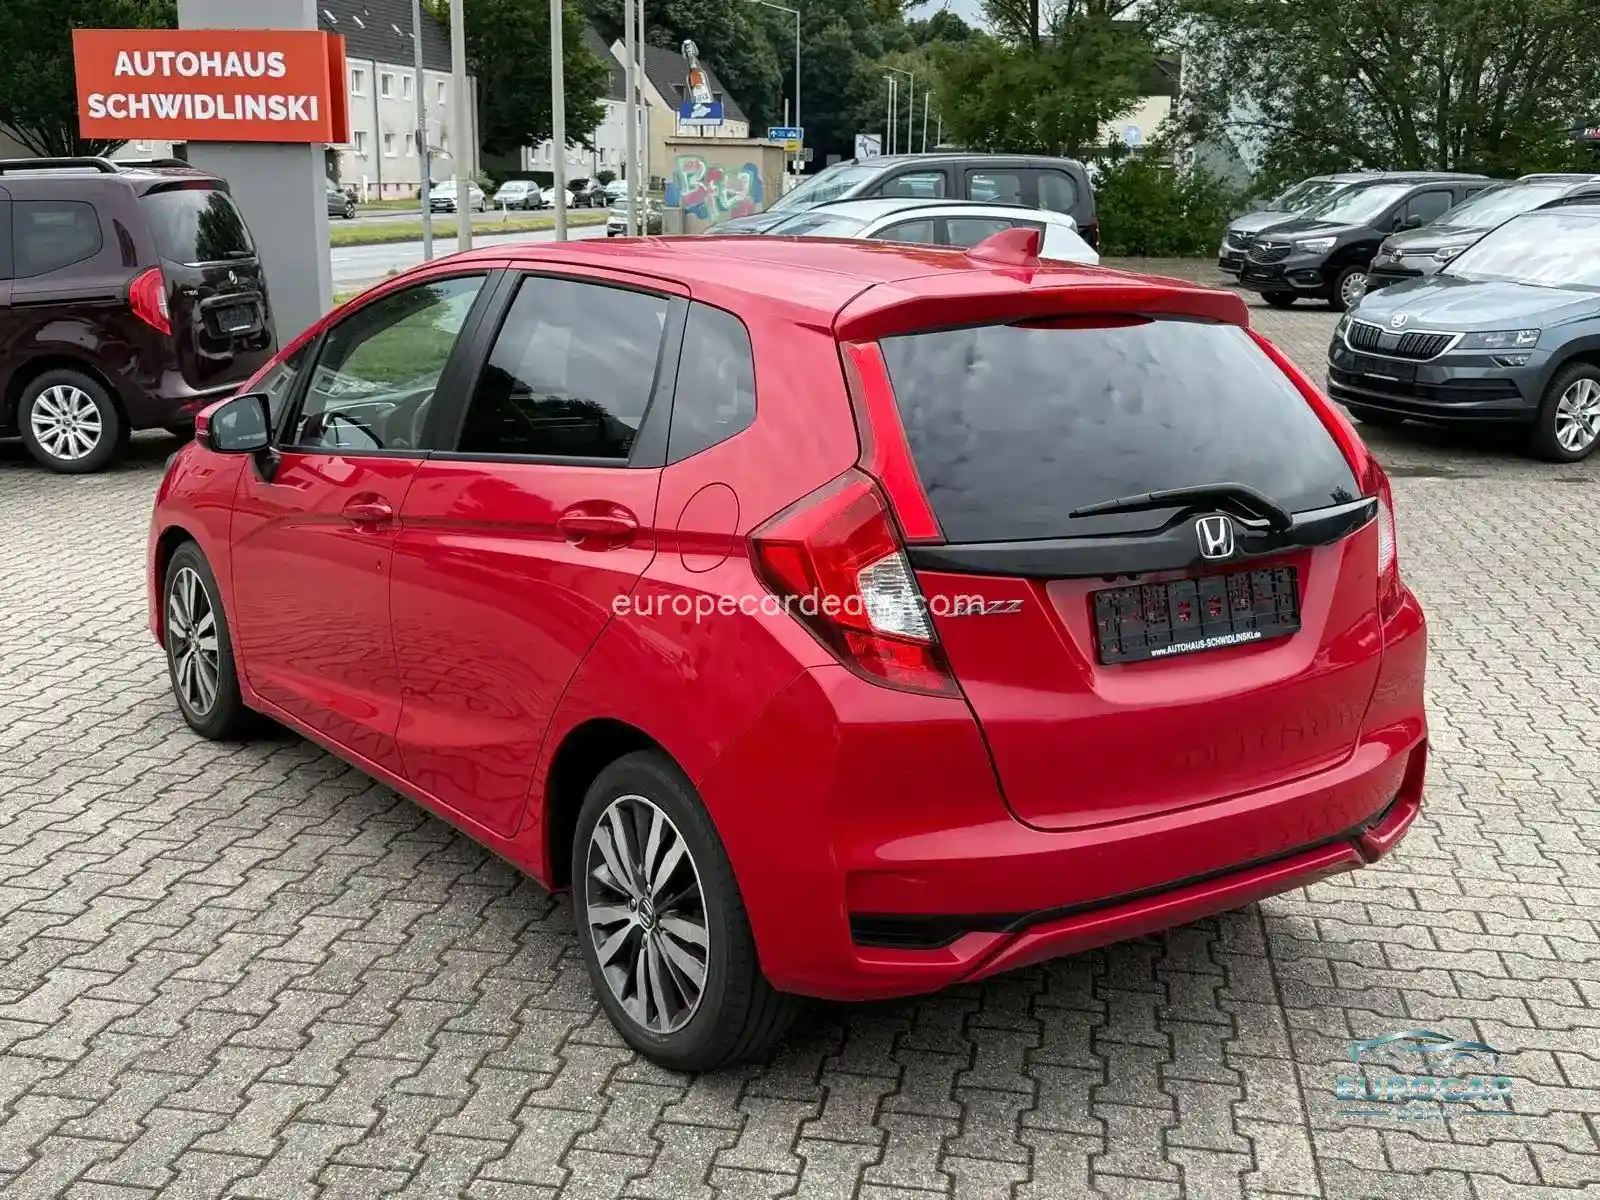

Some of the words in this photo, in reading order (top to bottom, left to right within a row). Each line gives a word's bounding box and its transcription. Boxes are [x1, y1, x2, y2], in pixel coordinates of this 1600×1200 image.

[114, 50, 287, 78] AUTOHAUS
[87, 93, 319, 121] SCHWIDLINSKI
[1151, 631, 1262, 657] www.AUTOHAUS-SCHWIDLINSKI.de
